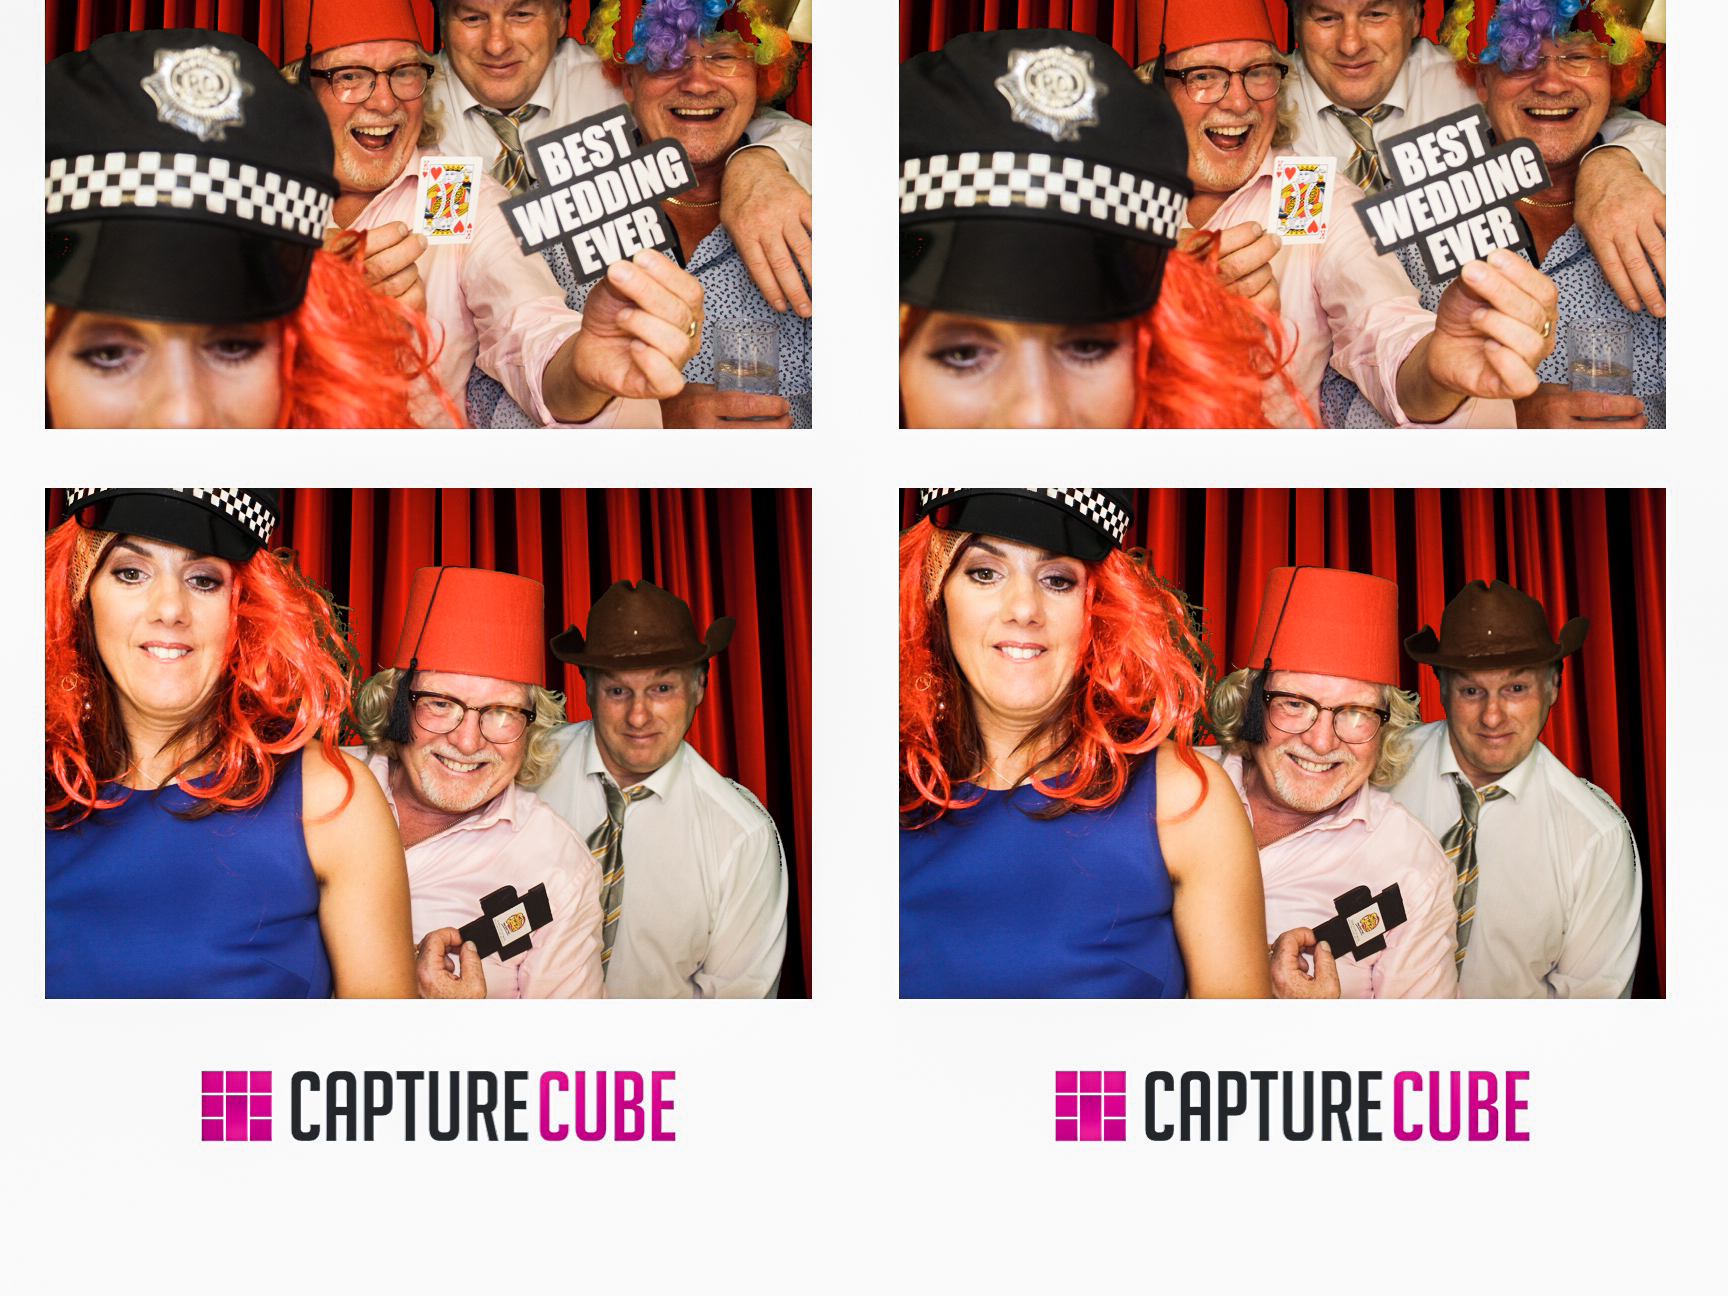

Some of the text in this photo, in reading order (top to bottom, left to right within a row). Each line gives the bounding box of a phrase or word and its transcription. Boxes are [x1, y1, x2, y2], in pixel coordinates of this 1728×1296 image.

[422, 160, 430, 170] K
[537, 115, 632, 187] BEST
[1276, 160, 1284, 170] K
[1391, 115, 1486, 187] BEST
[512, 146, 689, 247] WEDDING
[1366, 146, 1543, 247] WEDDING
[571, 206, 666, 275] EVER
[1425, 206, 1520, 275] EVER
